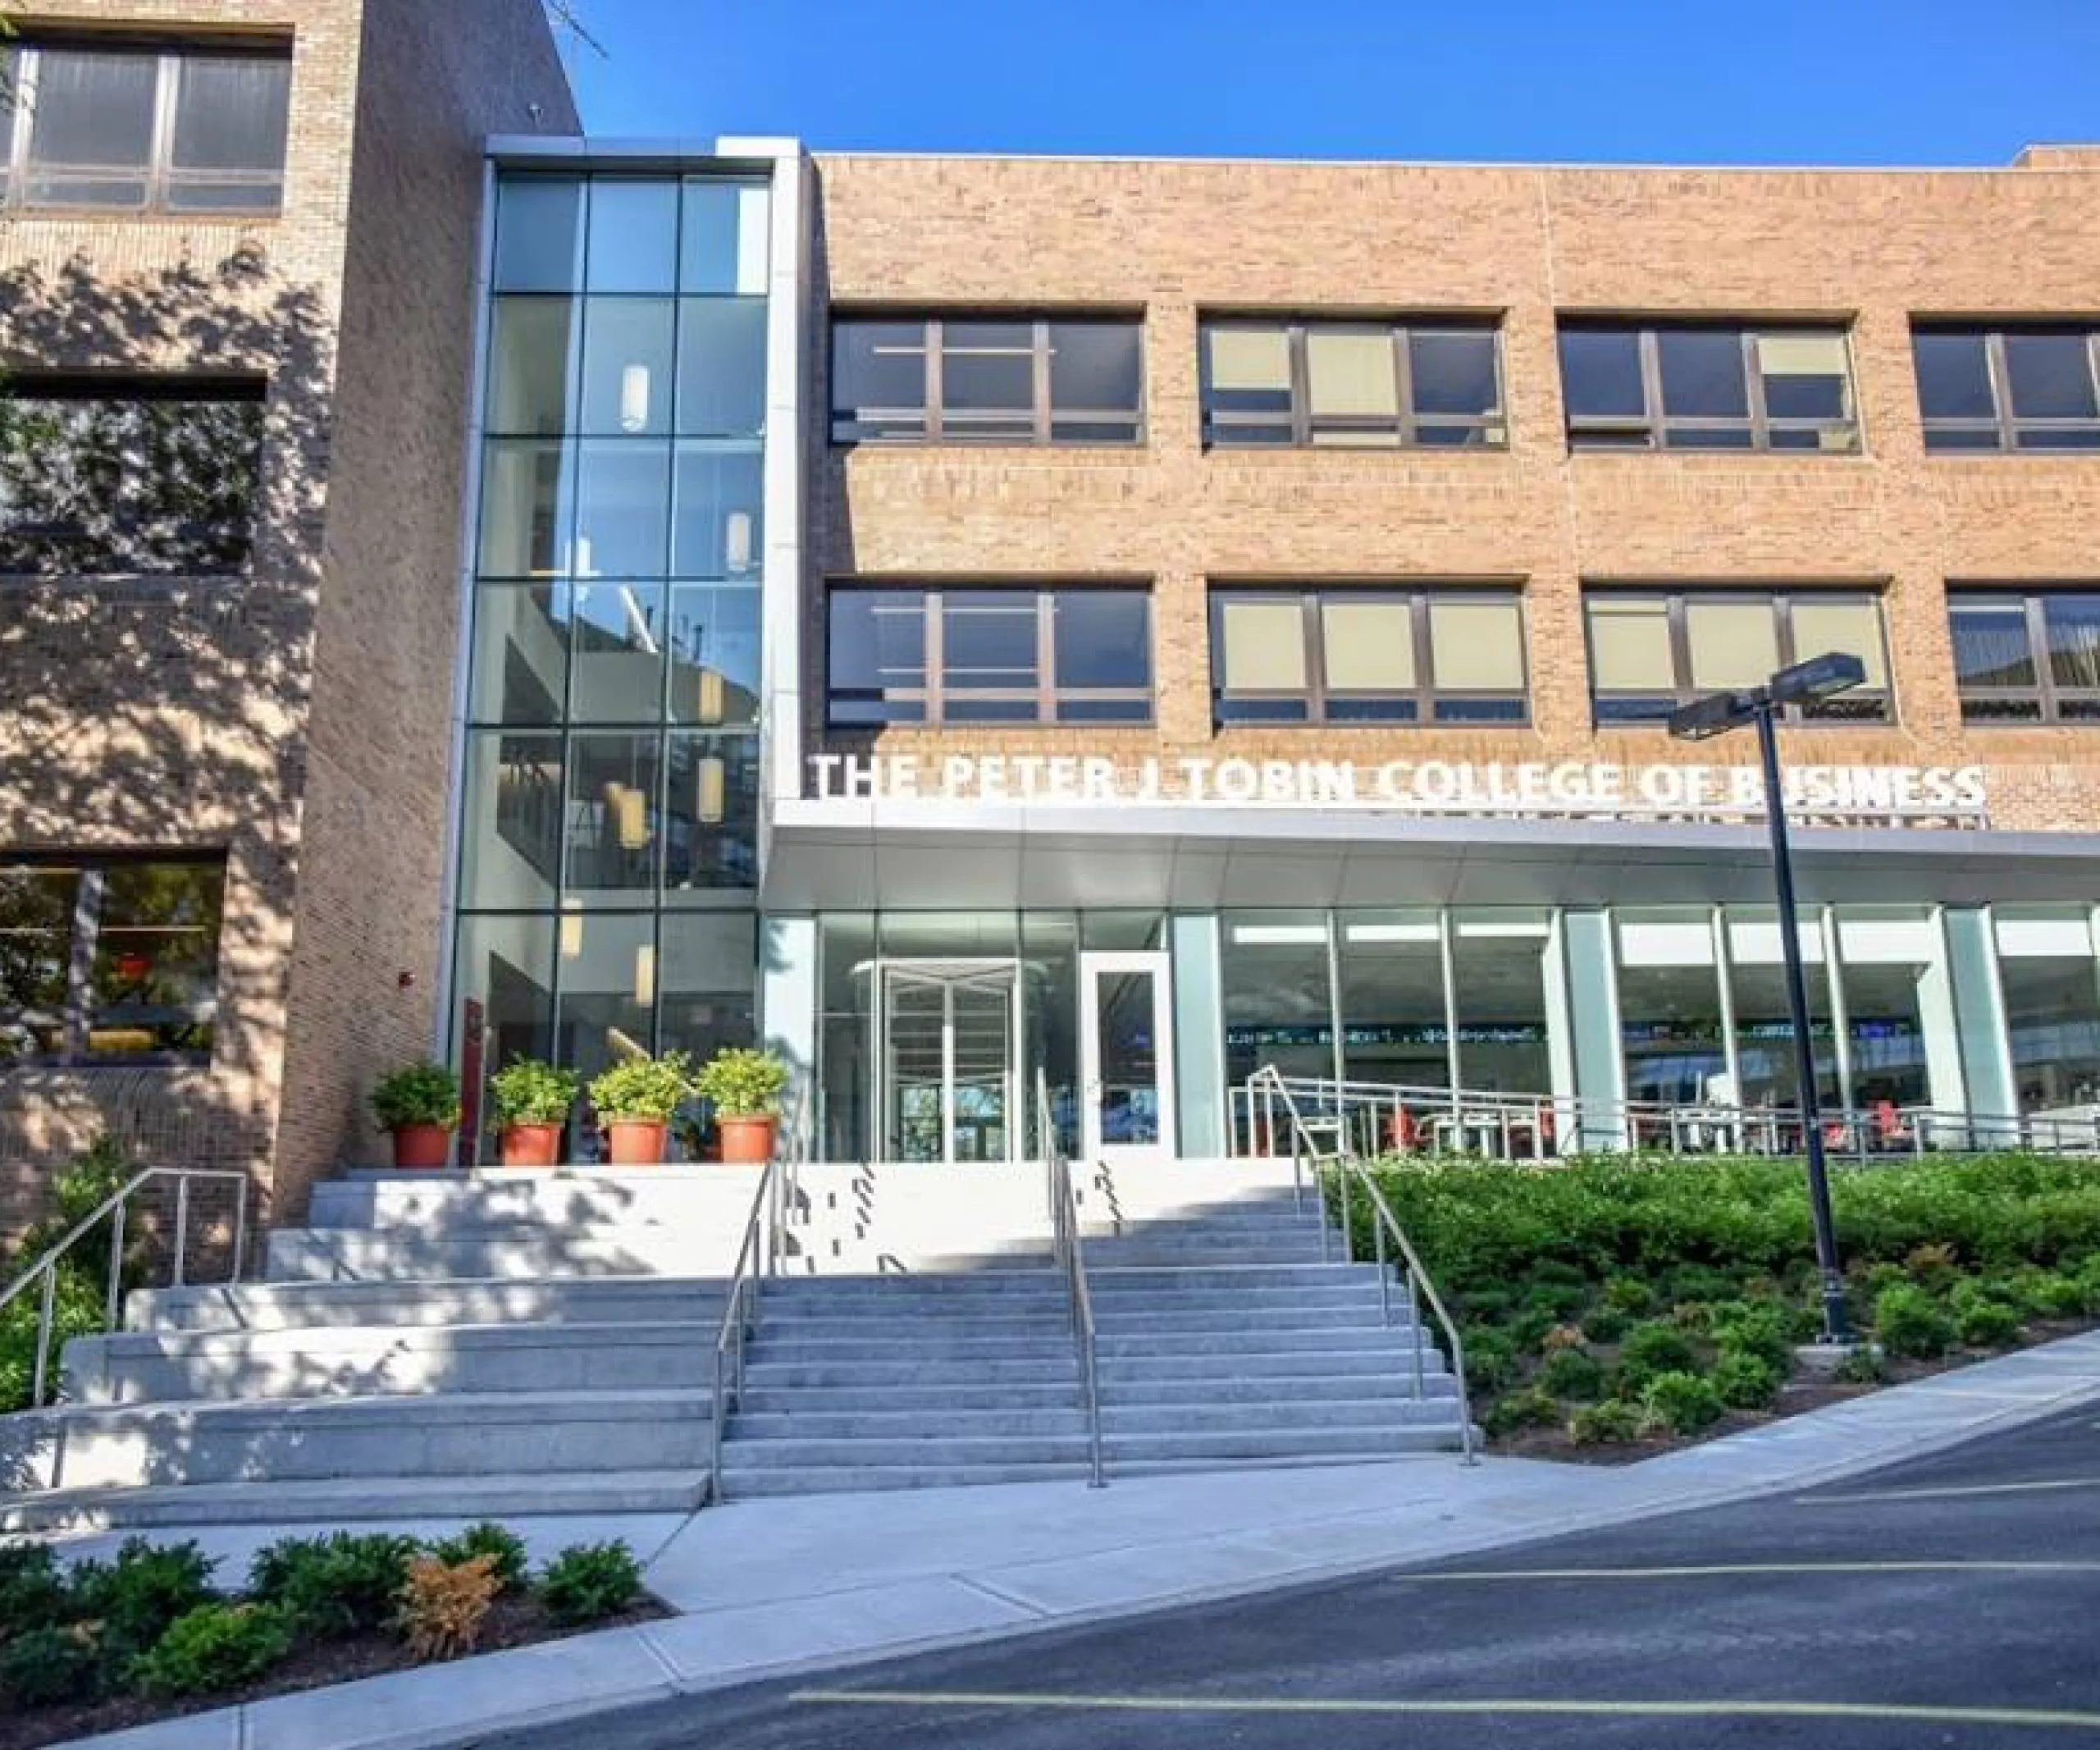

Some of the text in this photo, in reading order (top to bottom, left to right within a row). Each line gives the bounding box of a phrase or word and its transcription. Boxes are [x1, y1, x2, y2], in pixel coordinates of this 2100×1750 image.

[806, 754, 917, 800] THE
[945, 755, 1114, 802] PETER
[1180, 757, 1354, 802] TOBIN
[1379, 761, 1620, 804] COLLEGE
[1641, 765, 1711, 806] OF
